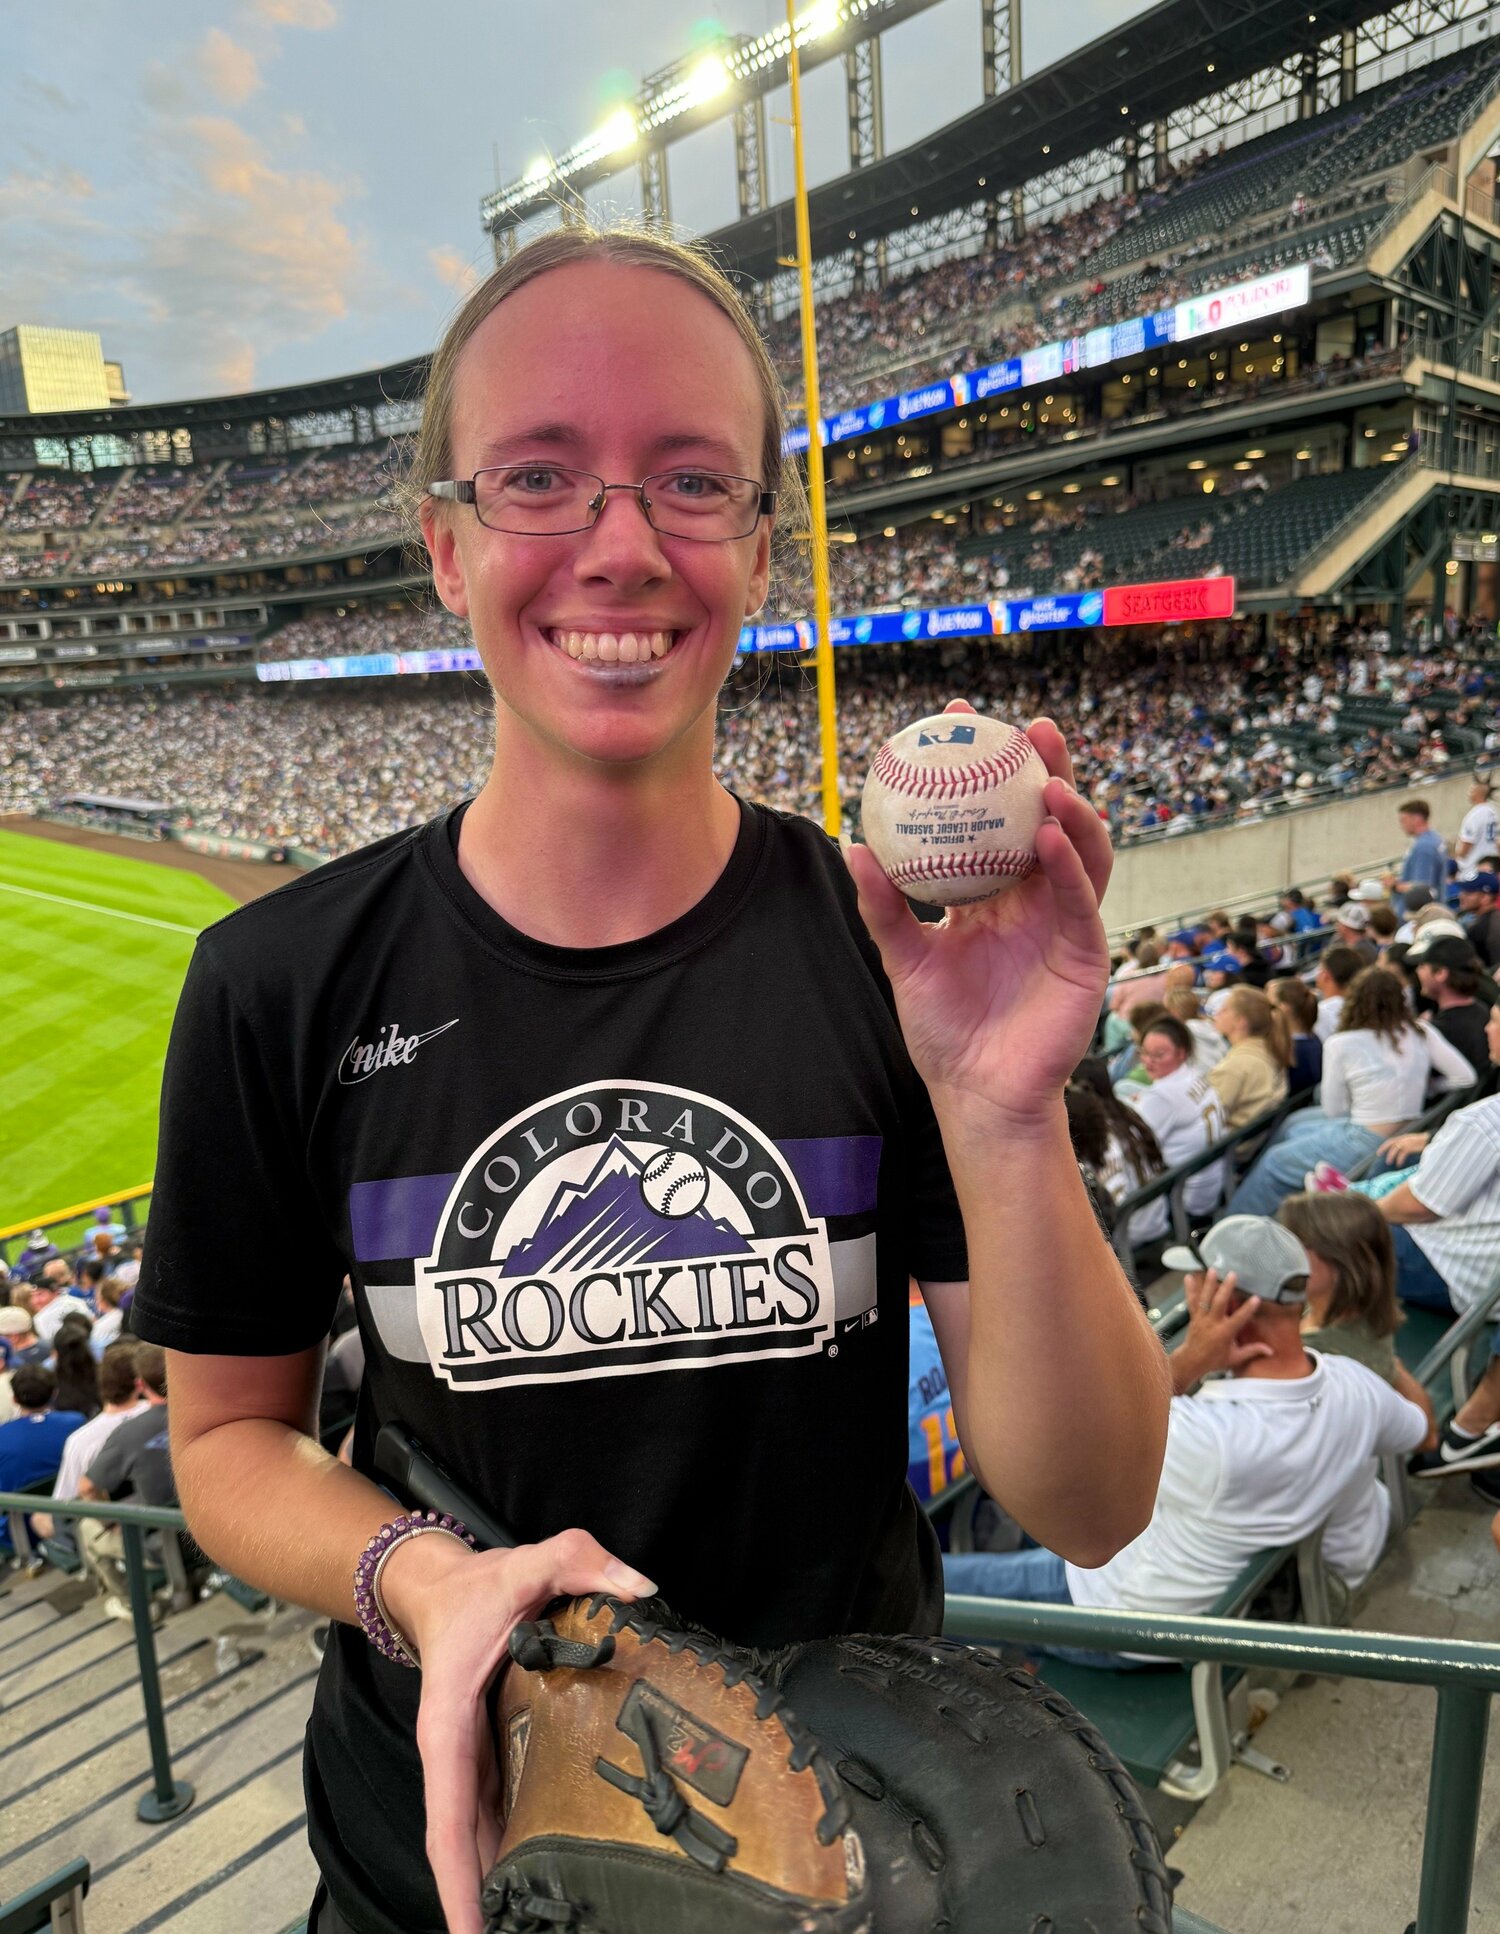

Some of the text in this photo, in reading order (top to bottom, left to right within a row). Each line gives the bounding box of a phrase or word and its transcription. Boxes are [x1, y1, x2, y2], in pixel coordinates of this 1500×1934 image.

[895, 817, 1005, 835] MAJOR LEAGUE BASEBALL
[930, 834, 965, 845] OFFICIAL
[457, 1098, 782, 1239] COLORADO
[434, 1243, 820, 1359] ROCKIES
